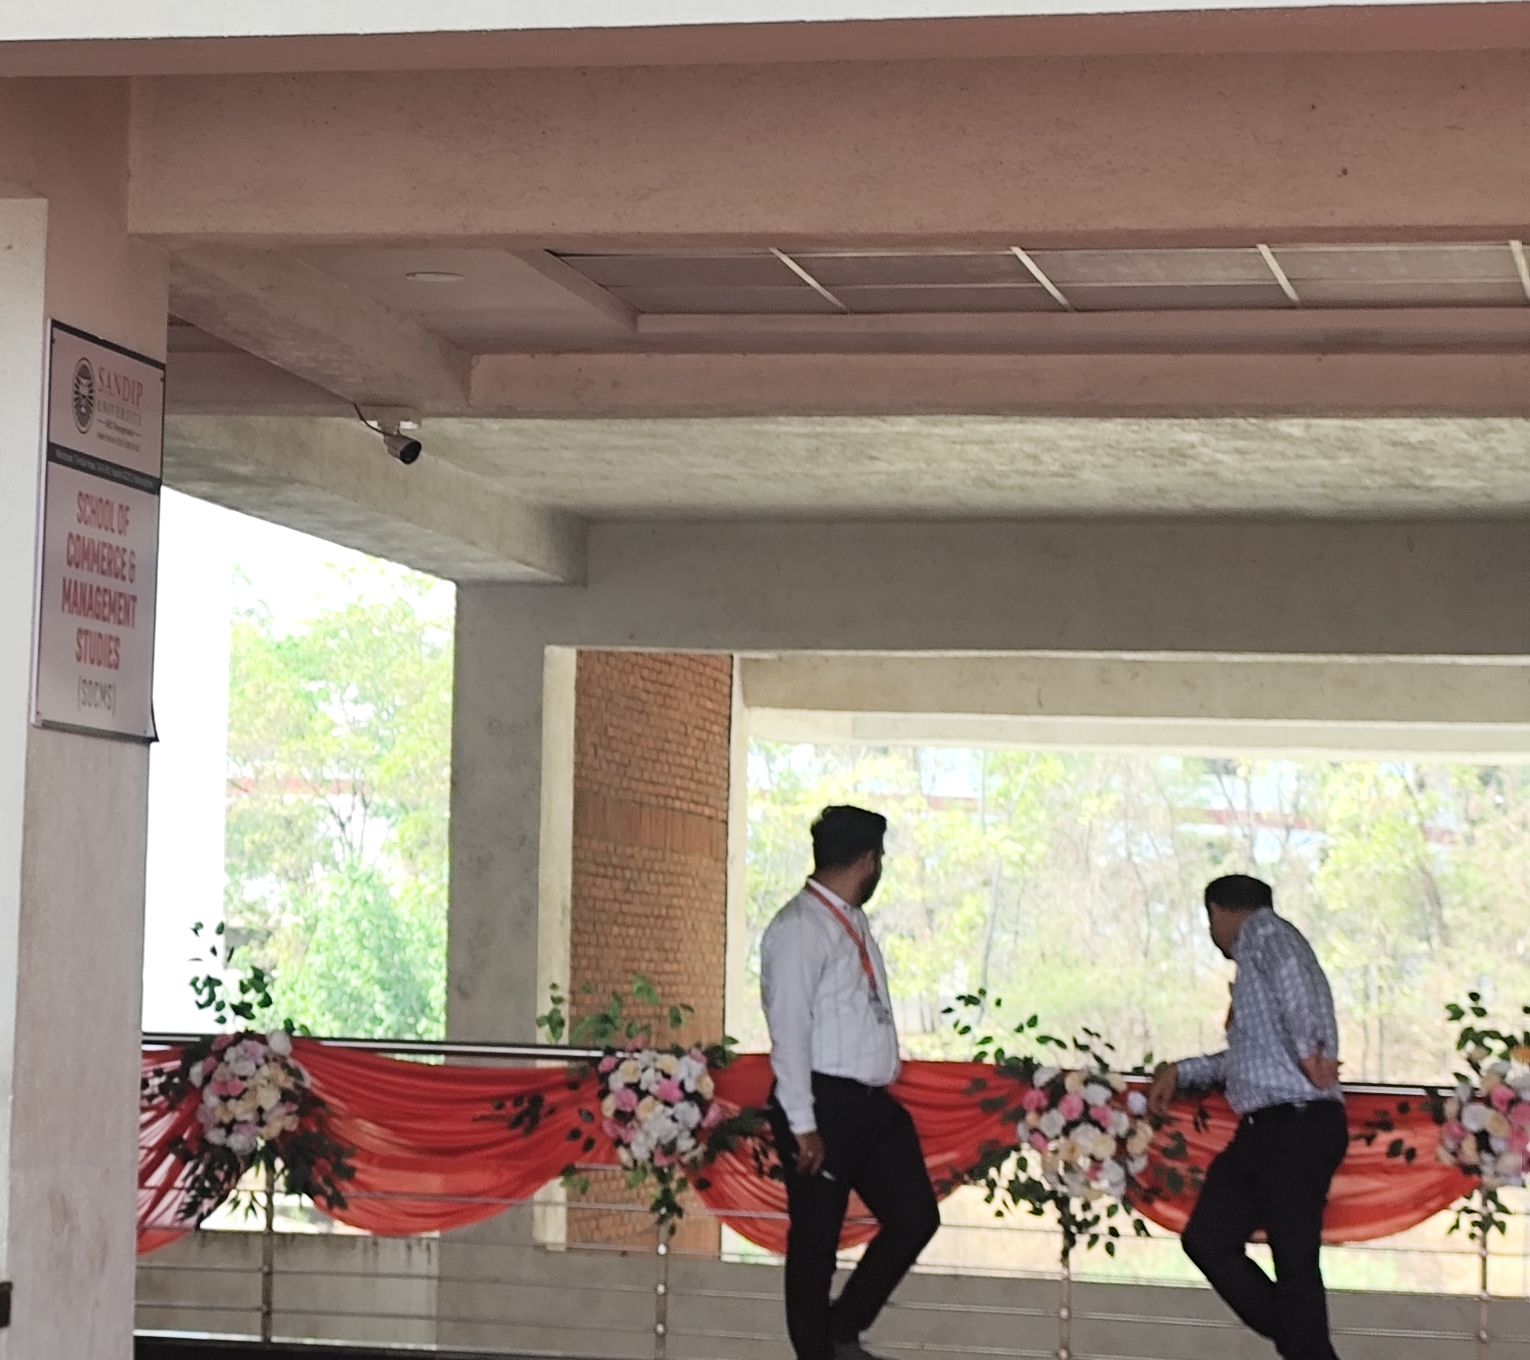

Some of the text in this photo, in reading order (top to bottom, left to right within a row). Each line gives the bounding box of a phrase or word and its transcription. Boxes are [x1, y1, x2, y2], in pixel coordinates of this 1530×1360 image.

[97, 366, 144, 407] SANDIP
[76, 490, 130, 537] SCHOOL OF
[66, 531, 127, 582] COMMERCE
[61, 577, 138, 629] MANAGEMENT
[75, 627, 121, 671] STUDIES
